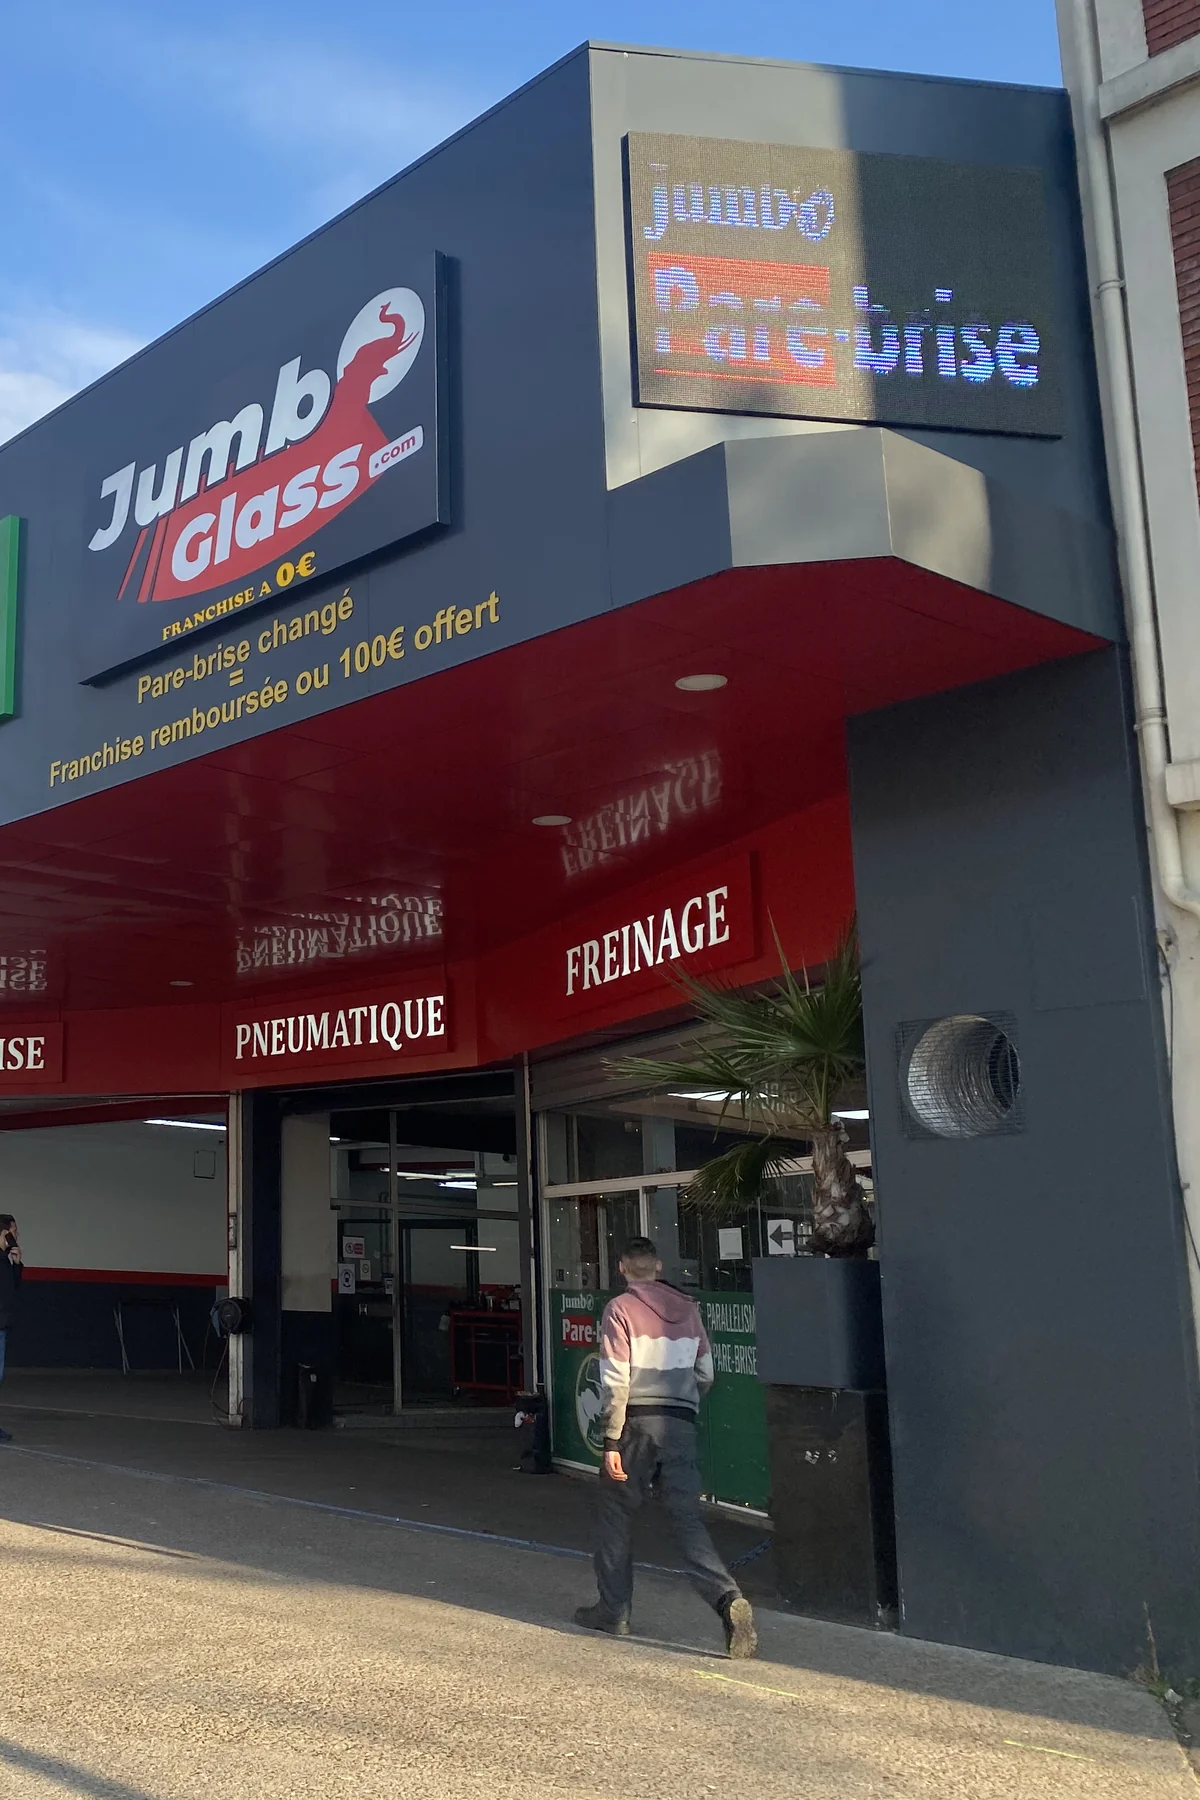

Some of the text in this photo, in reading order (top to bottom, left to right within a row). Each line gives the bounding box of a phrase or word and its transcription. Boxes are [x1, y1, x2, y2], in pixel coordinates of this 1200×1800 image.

[169, 442, 364, 582] Glass
[137, 587, 355, 705] Pare-brise changé
[162, 586, 256, 641] FRANCHISE
[259, 580, 272, 597] A
[49, 589, 501, 788] Franchise remboursée ou 100€ offert
[565, 885, 731, 996] FREINAGE
[235, 995, 446, 1060] PNEUMATIQUE
